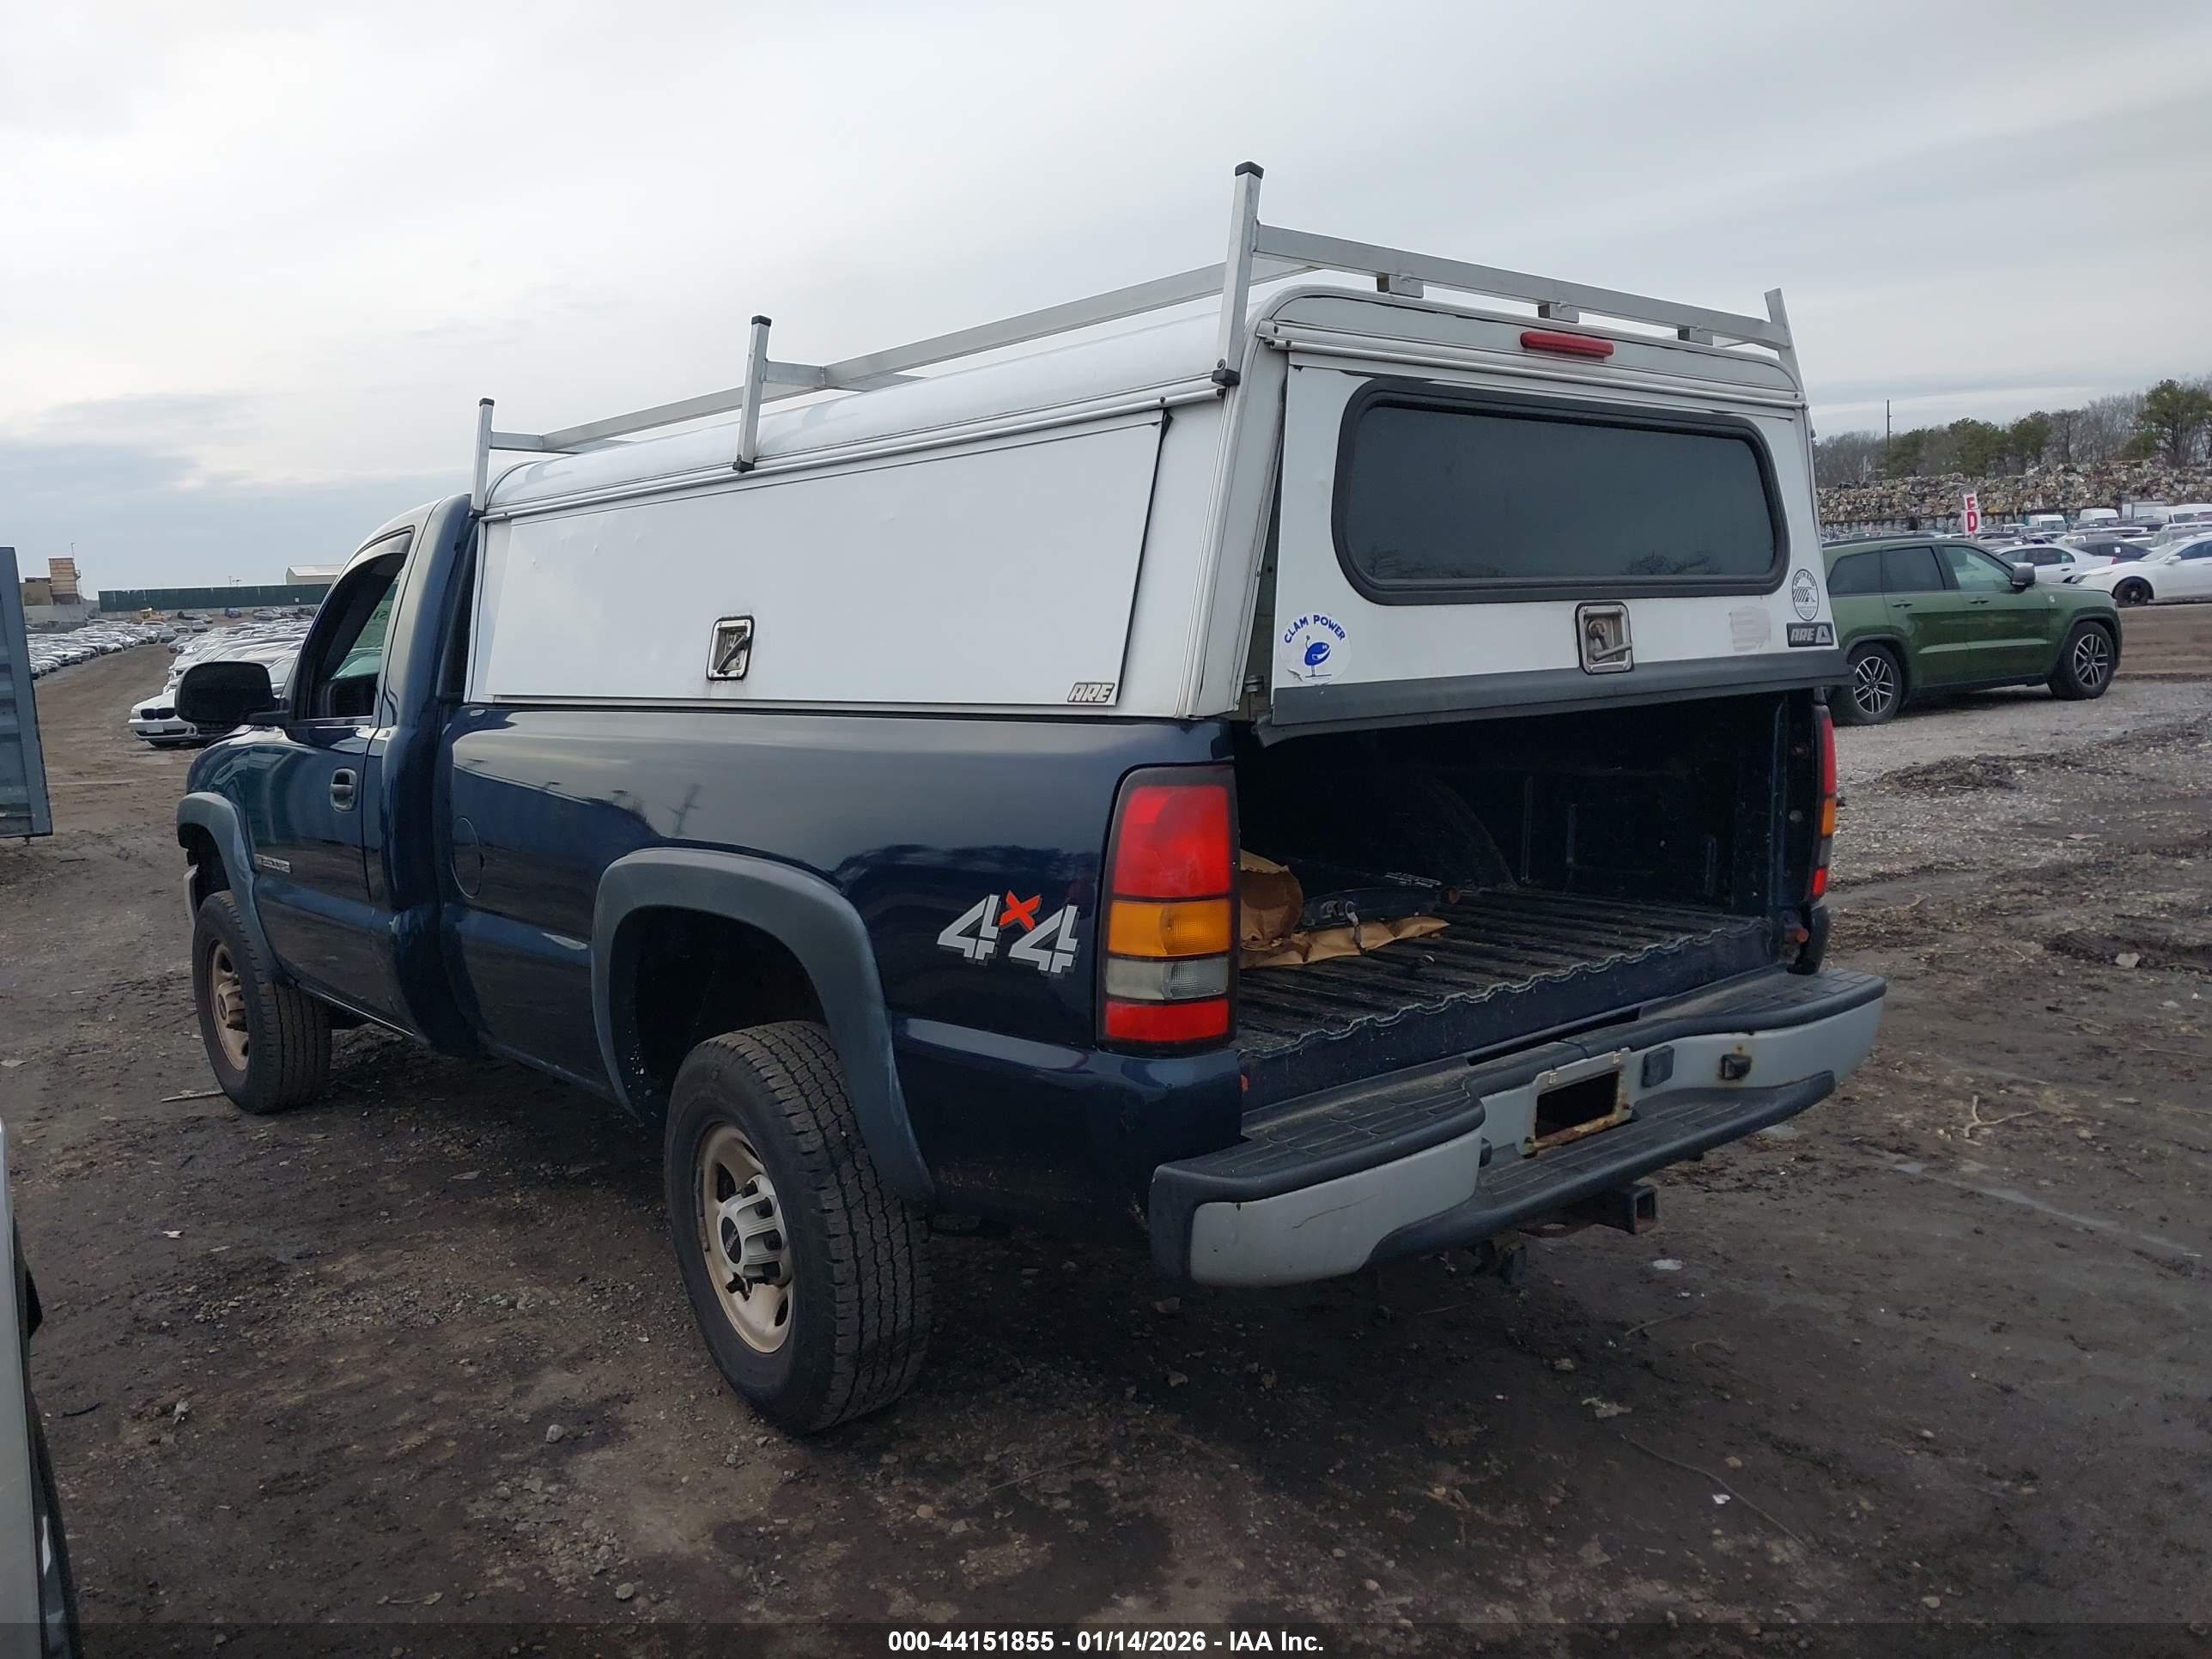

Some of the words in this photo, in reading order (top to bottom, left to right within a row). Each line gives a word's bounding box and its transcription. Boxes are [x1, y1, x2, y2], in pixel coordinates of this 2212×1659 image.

[1967, 512, 1978, 532] D
[1285, 617, 1309, 643] CLAM
[1313, 615, 1346, 641] POWER
[1067, 683, 1115, 702] ARE
